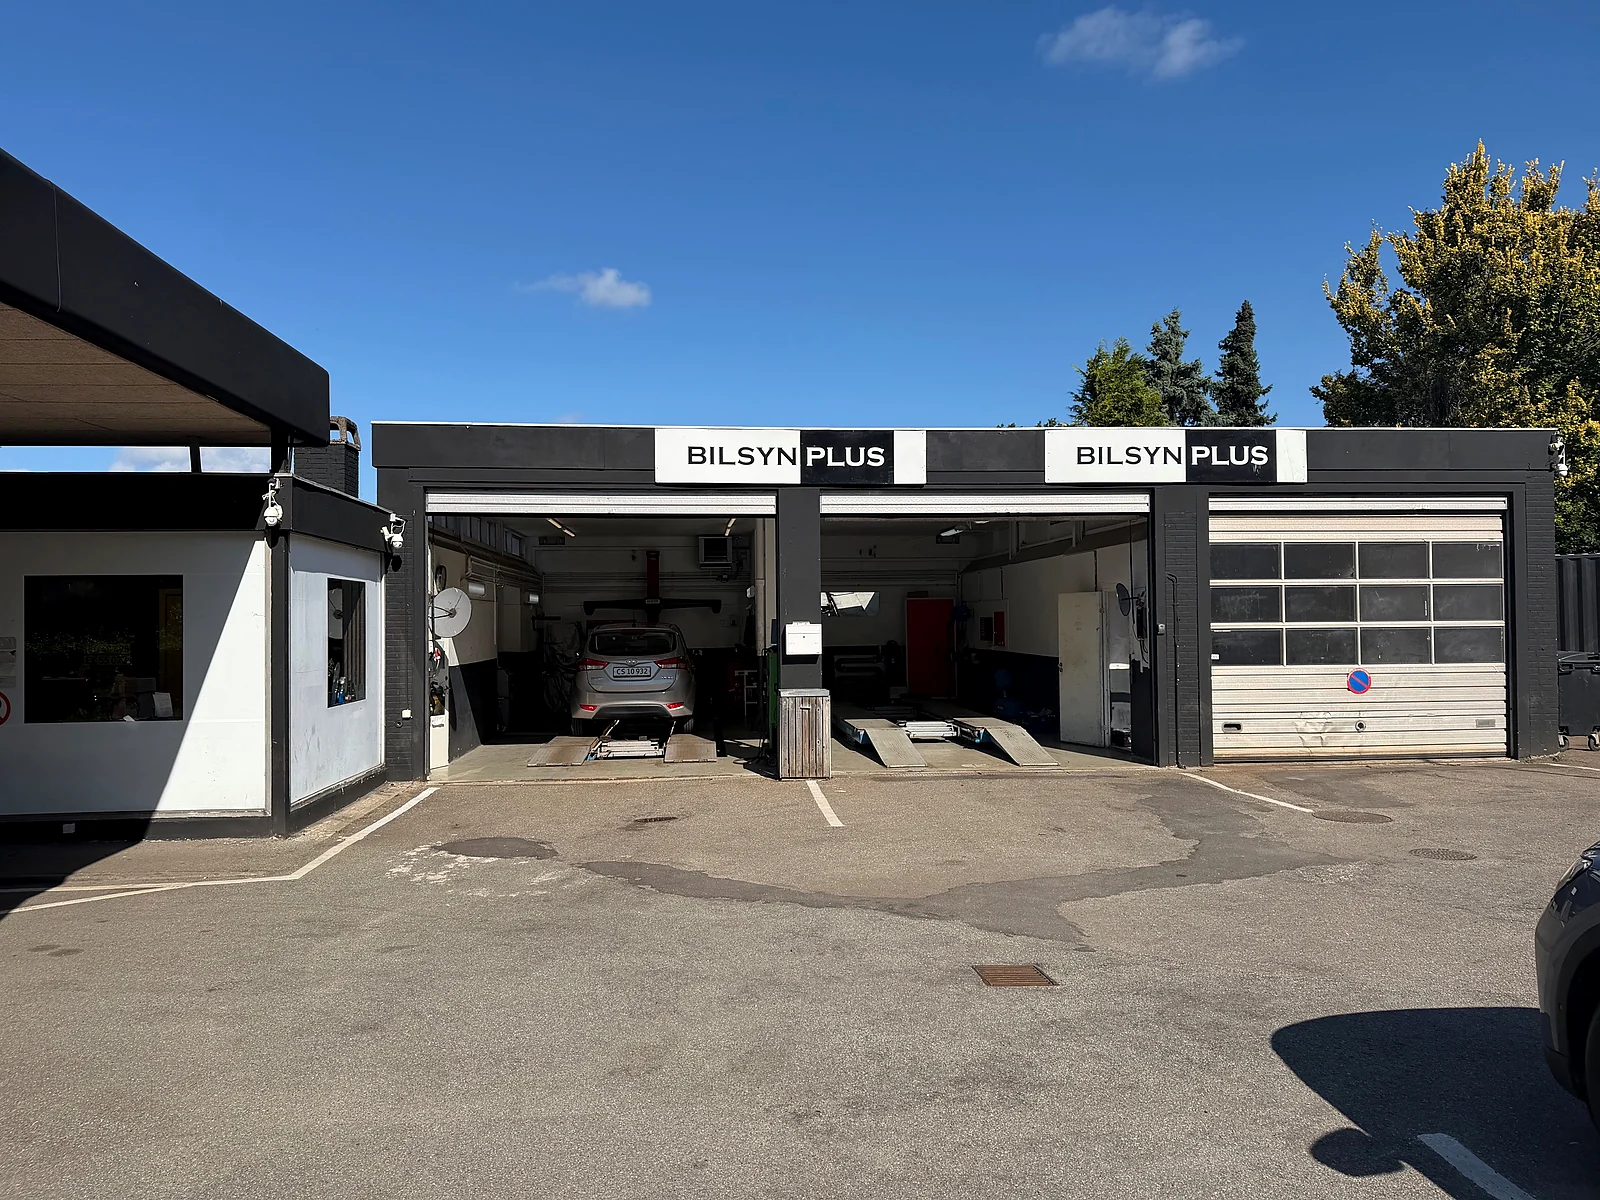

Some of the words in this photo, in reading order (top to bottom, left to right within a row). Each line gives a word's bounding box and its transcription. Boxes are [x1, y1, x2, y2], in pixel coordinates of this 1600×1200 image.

[688, 446, 797, 466] BILSYN
[806, 445, 885, 467] PLUS
[1077, 446, 1182, 465] BILSYN
[1191, 445, 1269, 466] PLUS
